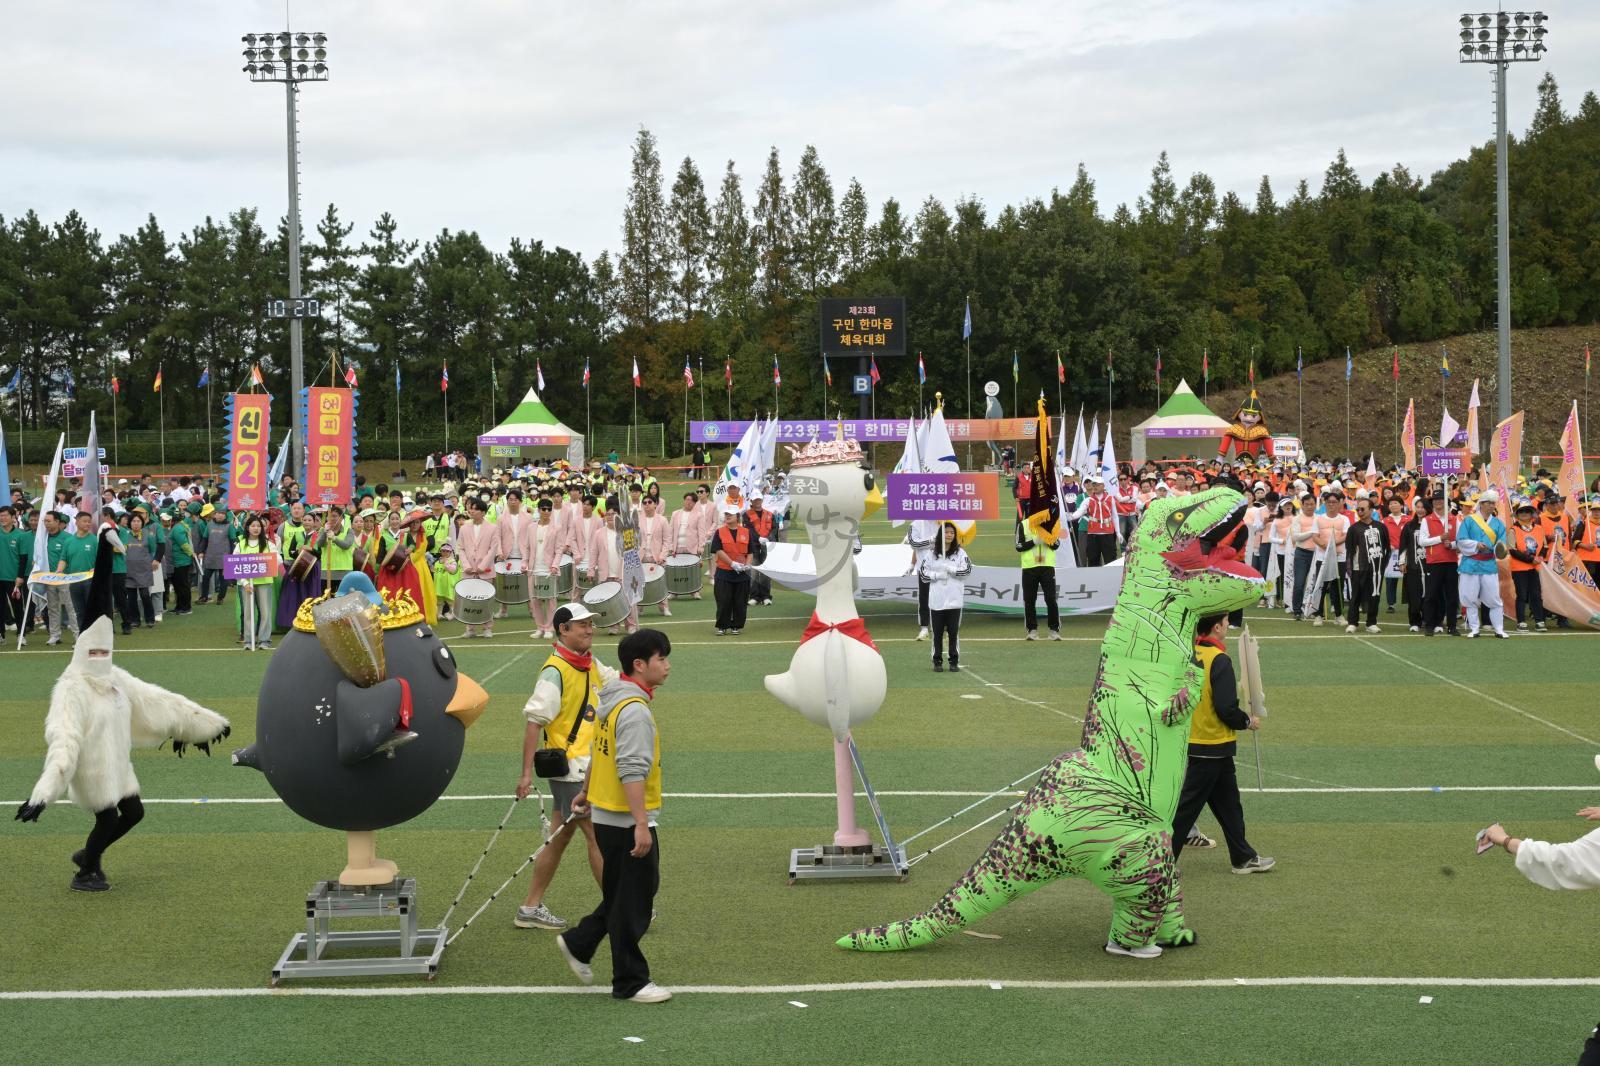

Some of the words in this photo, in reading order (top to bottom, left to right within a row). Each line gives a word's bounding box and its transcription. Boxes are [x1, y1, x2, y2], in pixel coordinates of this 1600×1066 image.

[848, 305, 876, 315] 제23회
[832, 318, 855, 331] 구민
[859, 318, 893, 331] 한마음
[840, 333, 886, 346] 체육대회
[856, 377, 868, 392] B
[776, 423, 820, 438] 23회
[1432, 458, 1461, 469] 신정1동
[908, 483, 948, 495] 제23회
[953, 483, 976, 495] 구민
[902, 499, 983, 511] 한마음체육대회
[233, 562, 267, 575] 신정2동
